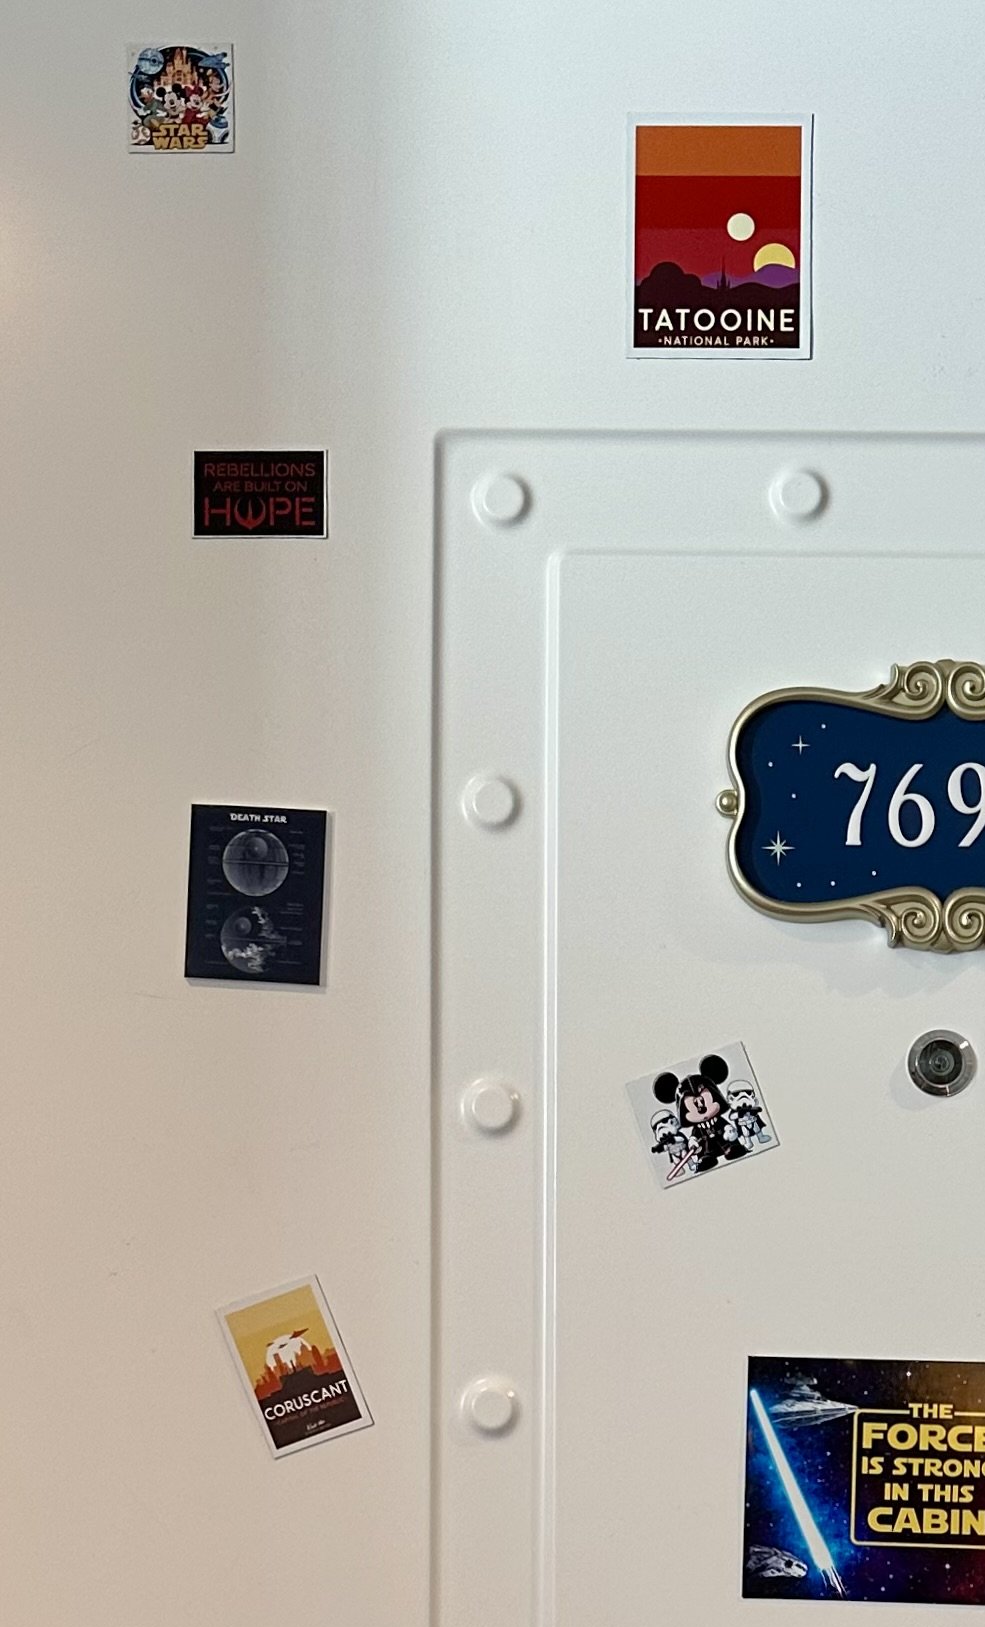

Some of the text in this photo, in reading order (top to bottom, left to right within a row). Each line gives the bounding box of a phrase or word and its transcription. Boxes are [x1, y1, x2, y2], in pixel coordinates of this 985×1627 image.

[152, 124, 208, 137] STAR
[152, 136, 208, 150] WARS
[638, 308, 795, 332] TATOOINE
[663, 336, 768, 346] NATIONAL PARK
[204, 463, 316, 477] REBELLIONS
[212, 481, 308, 492] ARE BUILT ON
[203, 496, 316, 530] HOPE
[229, 813, 288, 824] DEATH STAR
[264, 1379, 349, 1421] CORUSCANT
[908, 1402, 954, 1419] THE
[861, 1456, 884, 1475] IS
[884, 1483, 975, 1503] IN THIS
